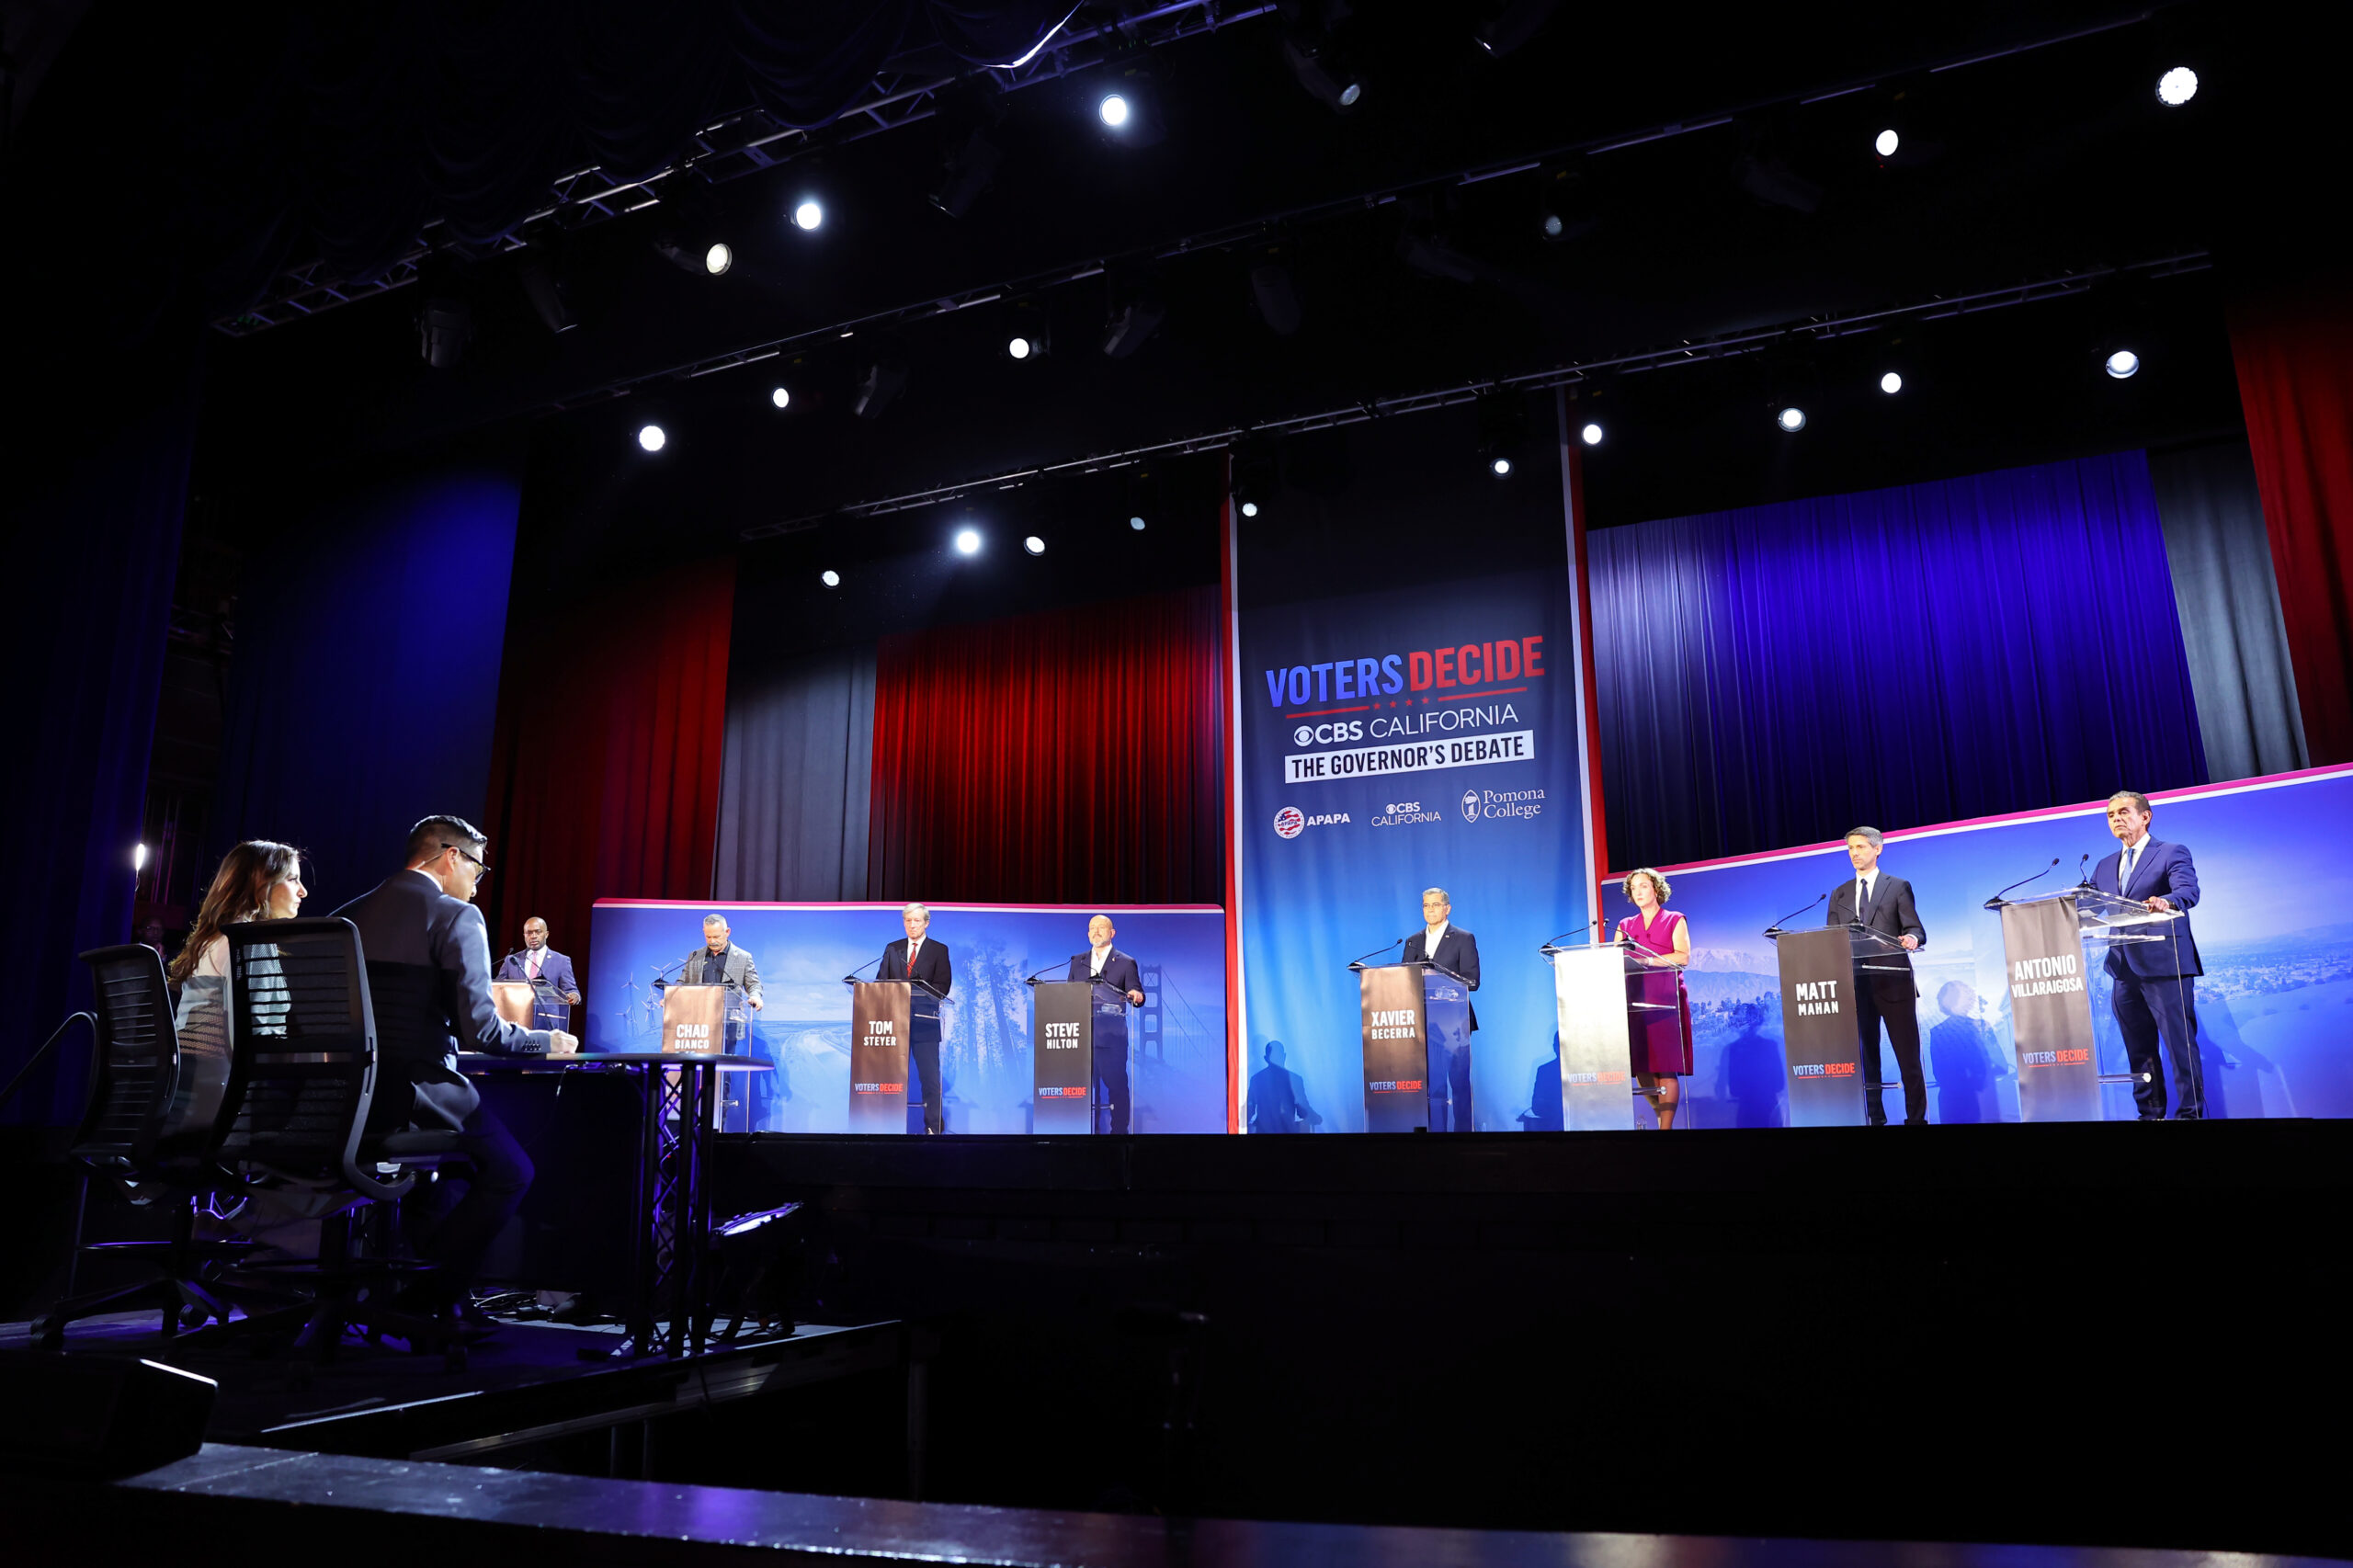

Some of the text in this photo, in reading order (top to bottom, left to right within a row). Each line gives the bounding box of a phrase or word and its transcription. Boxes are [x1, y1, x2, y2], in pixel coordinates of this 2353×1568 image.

[1266, 635, 1545, 708] VOTERS DECIDE
[1314, 703, 1519, 744] CBS CALIFORNIA
[1291, 735, 1525, 778] THE GOVERNOR'S DEBATE
[1483, 789, 1546, 805] Pomona
[1396, 801, 1421, 813] CBS
[1483, 802, 1542, 820] College
[1306, 812, 1351, 826] APAPA
[1371, 811, 1442, 827] CALIFORNIA
[2014, 954, 2077, 982] ANTONIO
[1795, 980, 1837, 1002] MATT
[2010, 976, 2085, 998] VILLARAIGOSA
[1798, 1001, 1839, 1017] MAHAN
[1370, 1009, 1415, 1027] XAVIER
[676, 1024, 710, 1038] CHAD
[869, 1020, 893, 1035] TOM
[1045, 1022, 1080, 1038] STEVE
[1371, 1027, 1415, 1040] BECERRA
[675, 1040, 710, 1050] BIANCO
[863, 1036, 897, 1046] STEYER
[1046, 1038, 1078, 1050] HILTON
[2022, 1048, 2089, 1064] VOTERS DECIDE
[1792, 1062, 1856, 1076] VOTERS DECIDE
[1568, 1072, 1597, 1083] VOTERS
[855, 1083, 904, 1092] VOTERS DECIDE
[1039, 1086, 1086, 1096] VOTERS DECIDE
[1370, 1080, 1423, 1091] VOTERS DECIDE
